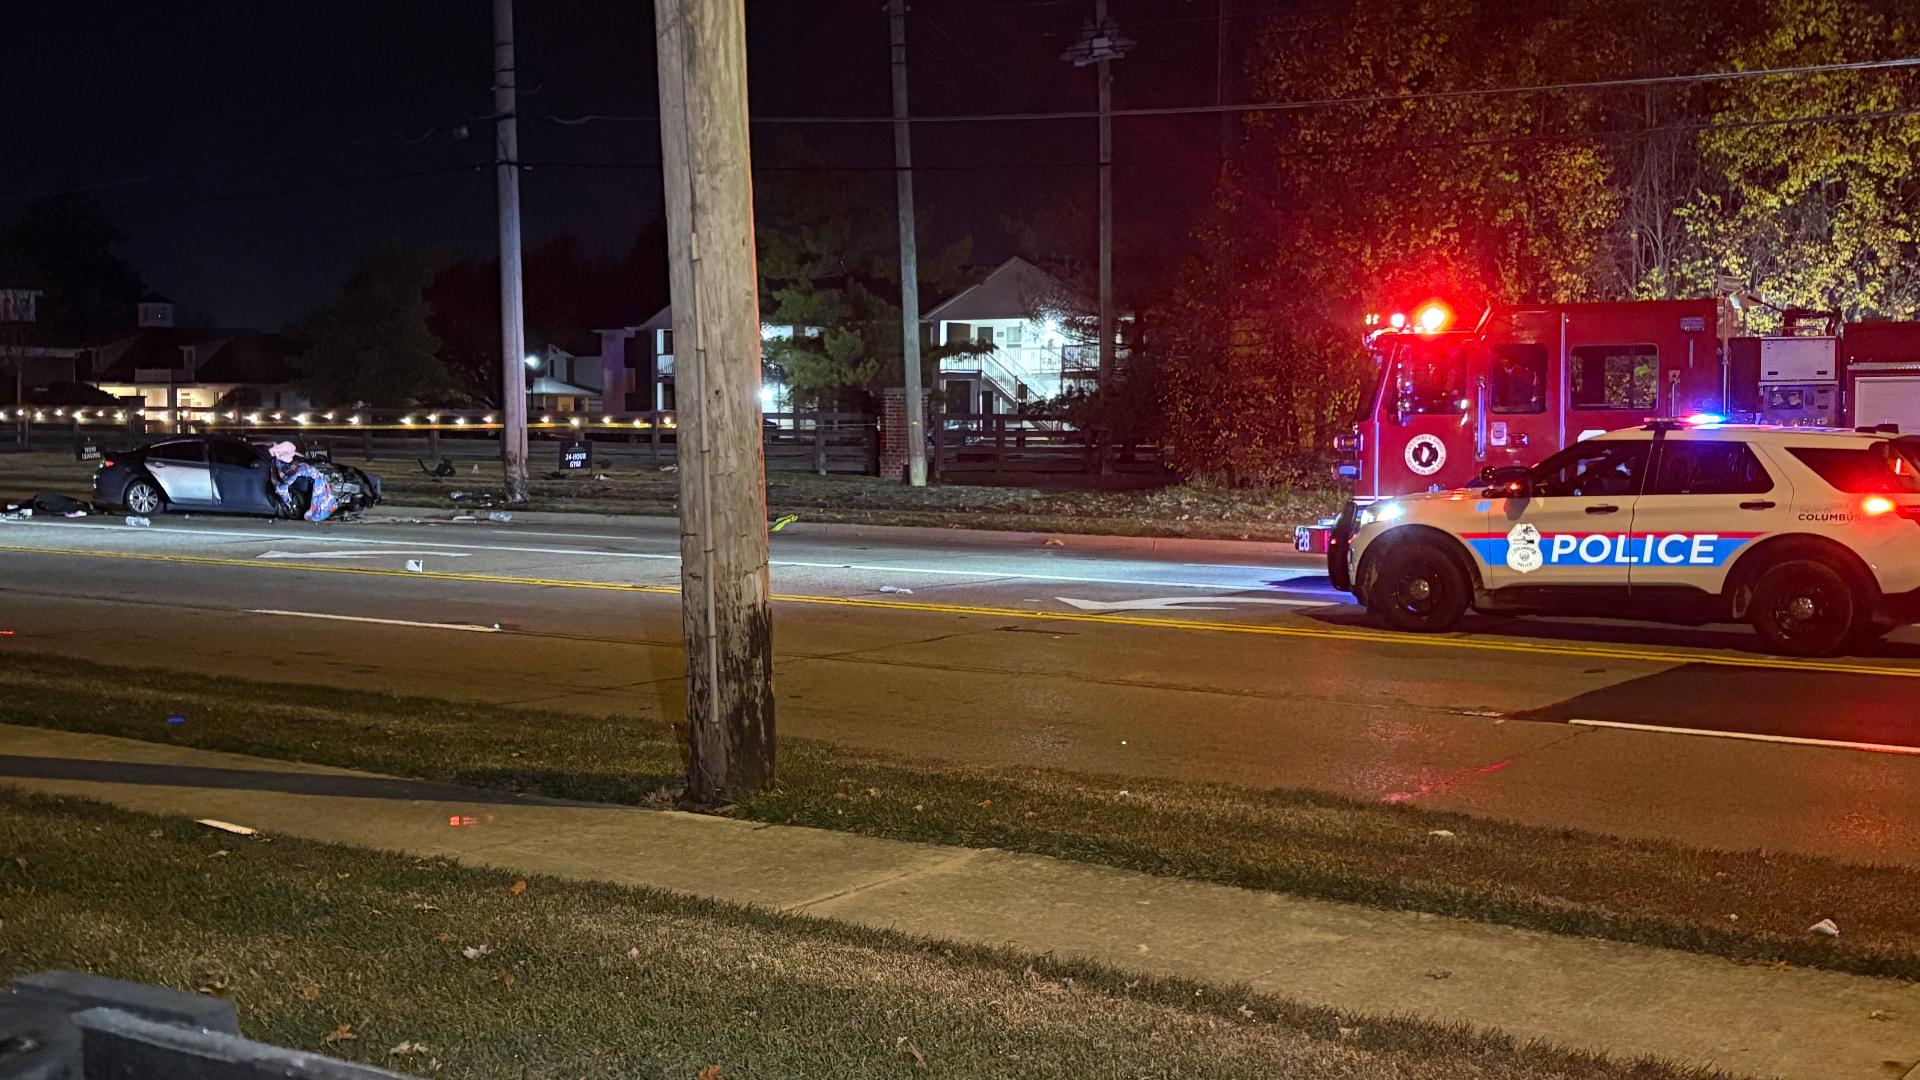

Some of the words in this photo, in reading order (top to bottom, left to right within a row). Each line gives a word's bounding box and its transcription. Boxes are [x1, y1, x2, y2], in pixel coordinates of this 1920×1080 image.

[565, 453, 587, 461] 24-HOUR
[569, 460, 582, 468] GYM
[1798, 513, 1861, 521] COLUMBUS
[1298, 529, 1310, 551] 28
[1551, 534, 1719, 564] POLICE
